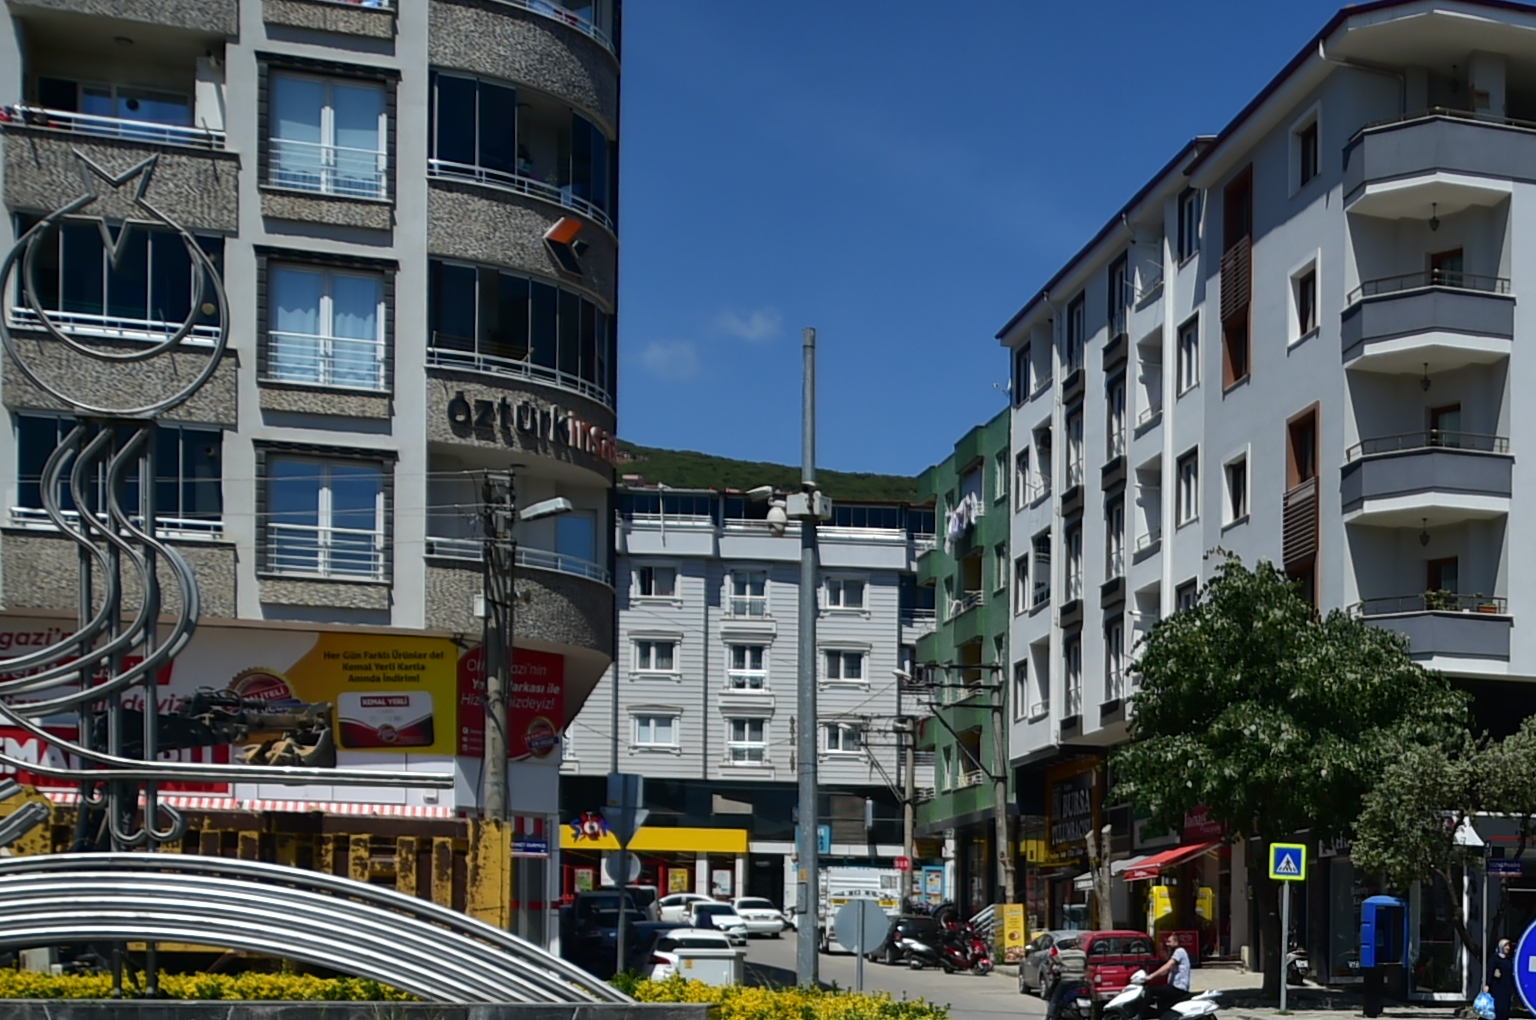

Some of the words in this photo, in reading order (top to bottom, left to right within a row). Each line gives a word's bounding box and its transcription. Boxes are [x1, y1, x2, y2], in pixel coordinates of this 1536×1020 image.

[323, 651, 340, 659] Her
[342, 651, 361, 659] Gün
[364, 651, 390, 659] Farklı
[392, 650, 427, 659] Ürünler
[342, 663, 372, 671] Kemal
[374, 663, 395, 671] Yerli
[398, 663, 425, 671] Kartla
[547, 682, 561, 694] ile
[1062, 789, 1091, 818] BURSA
